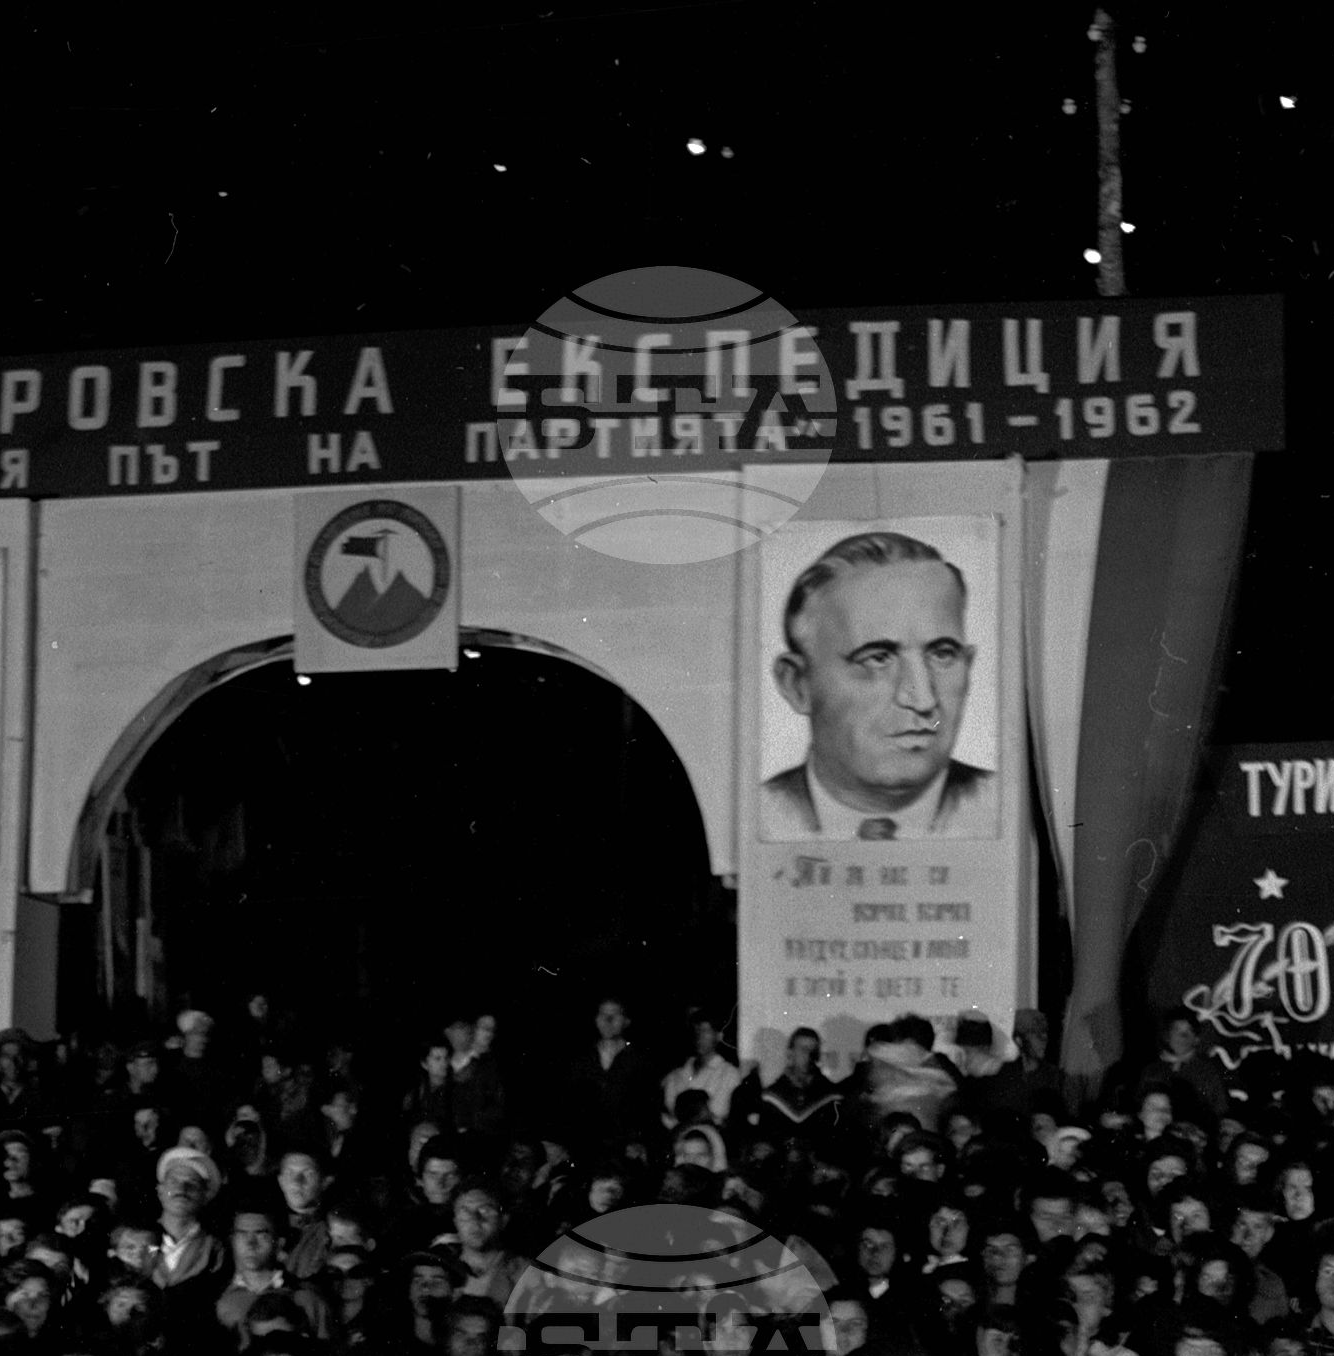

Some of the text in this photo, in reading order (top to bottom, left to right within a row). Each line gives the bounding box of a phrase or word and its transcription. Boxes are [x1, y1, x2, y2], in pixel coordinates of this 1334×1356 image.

[489, 310, 1203, 406] ЕКСПЕДИЦИЯ
[107, 439, 222, 487] ПЪТ
[307, 430, 382, 474] НА
